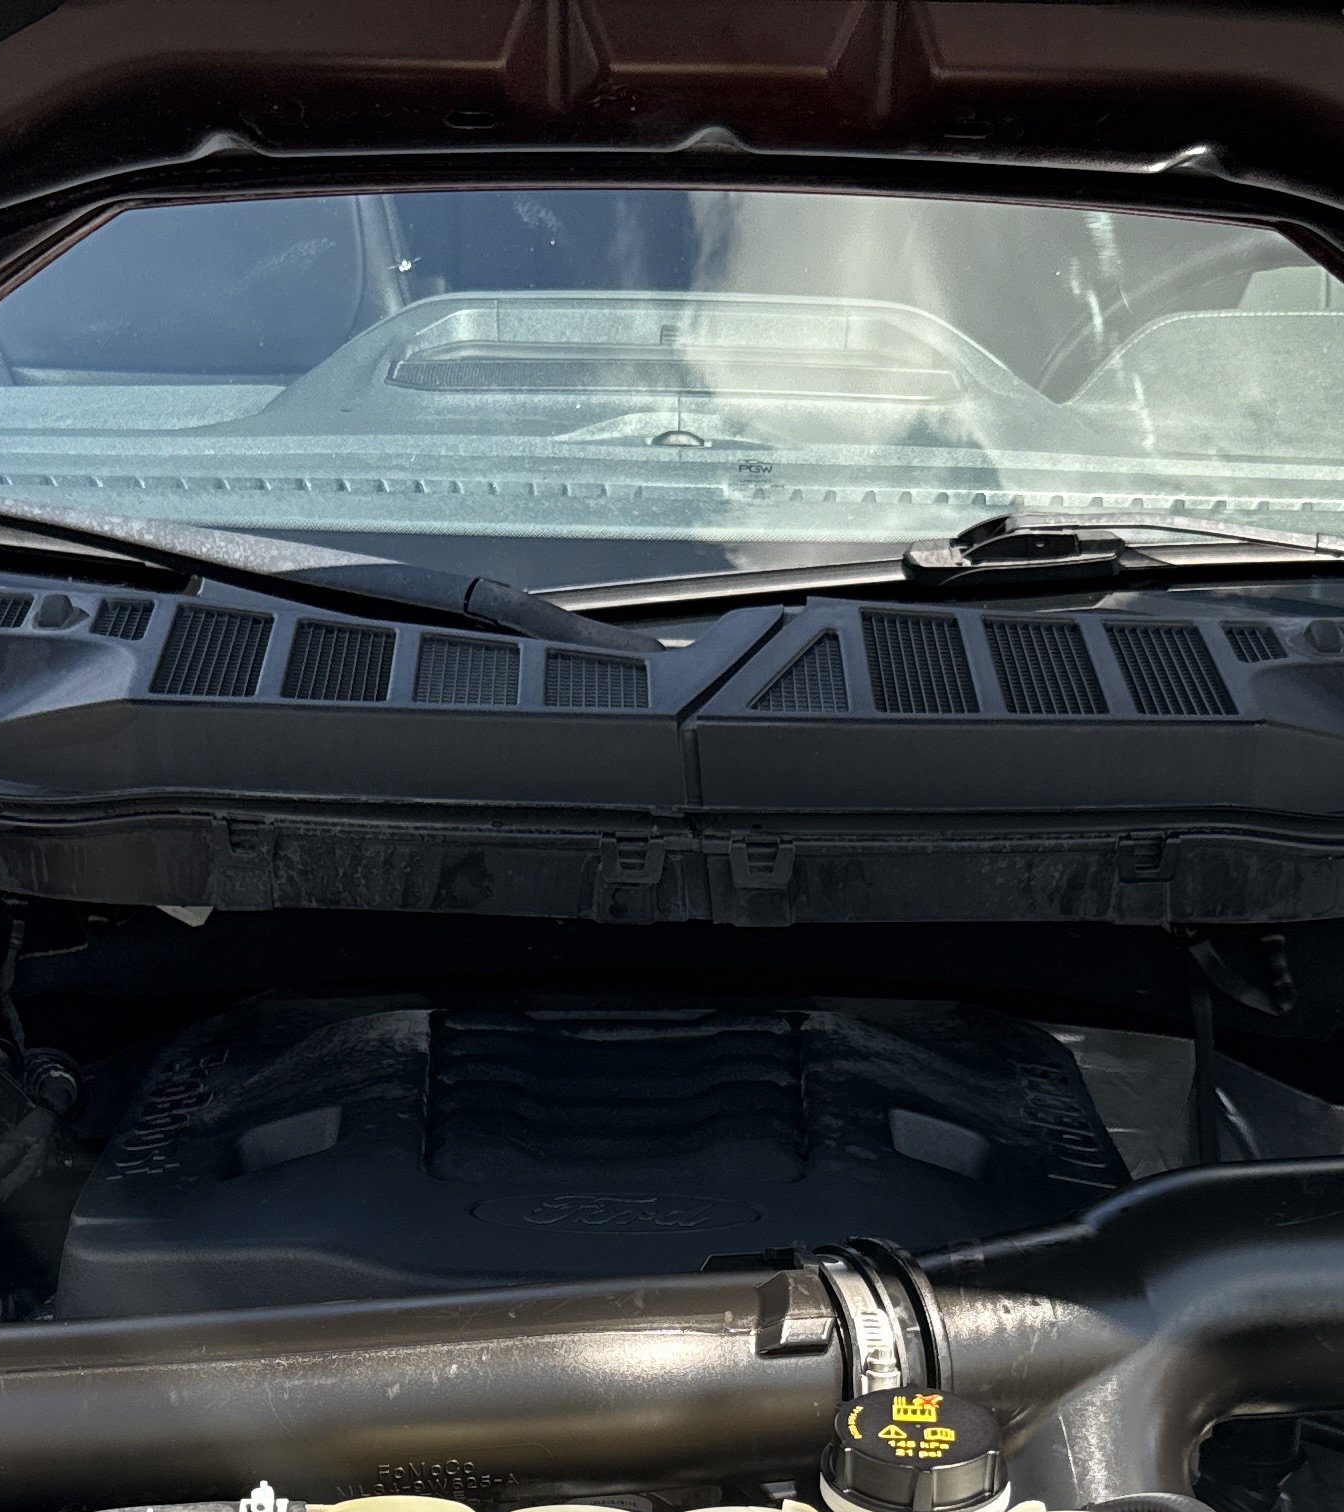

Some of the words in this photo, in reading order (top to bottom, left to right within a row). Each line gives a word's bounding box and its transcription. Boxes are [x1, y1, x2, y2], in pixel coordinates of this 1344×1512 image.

[738, 464, 773, 474] PGW
[522, 1194, 713, 1228] Ford
[377, 1458, 476, 1480] FoMoCo
